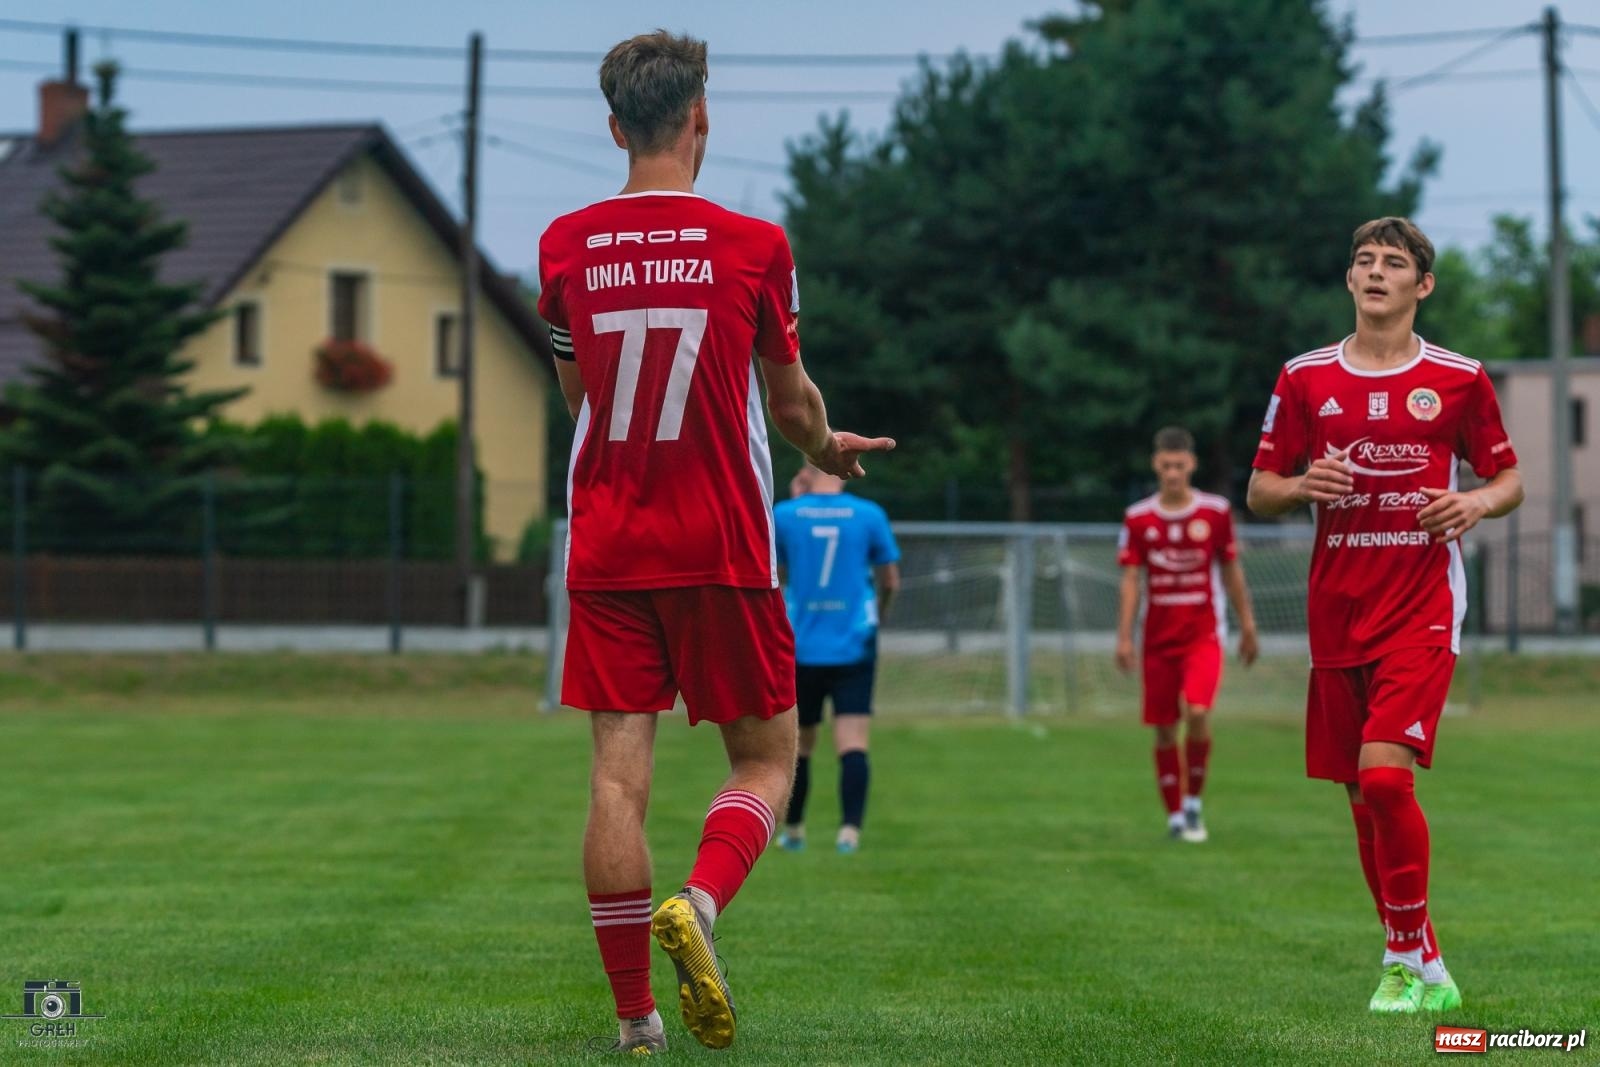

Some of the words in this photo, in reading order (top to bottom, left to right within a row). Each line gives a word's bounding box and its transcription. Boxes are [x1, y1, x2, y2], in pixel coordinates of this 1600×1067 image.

[586, 228, 708, 249] GROS
[585, 262, 636, 292] UNIA
[642, 258, 714, 285] TURZA
[592, 307, 708, 441] 77
[1347, 531, 1430, 547] WENINGER
[811, 526, 839, 588] 7
